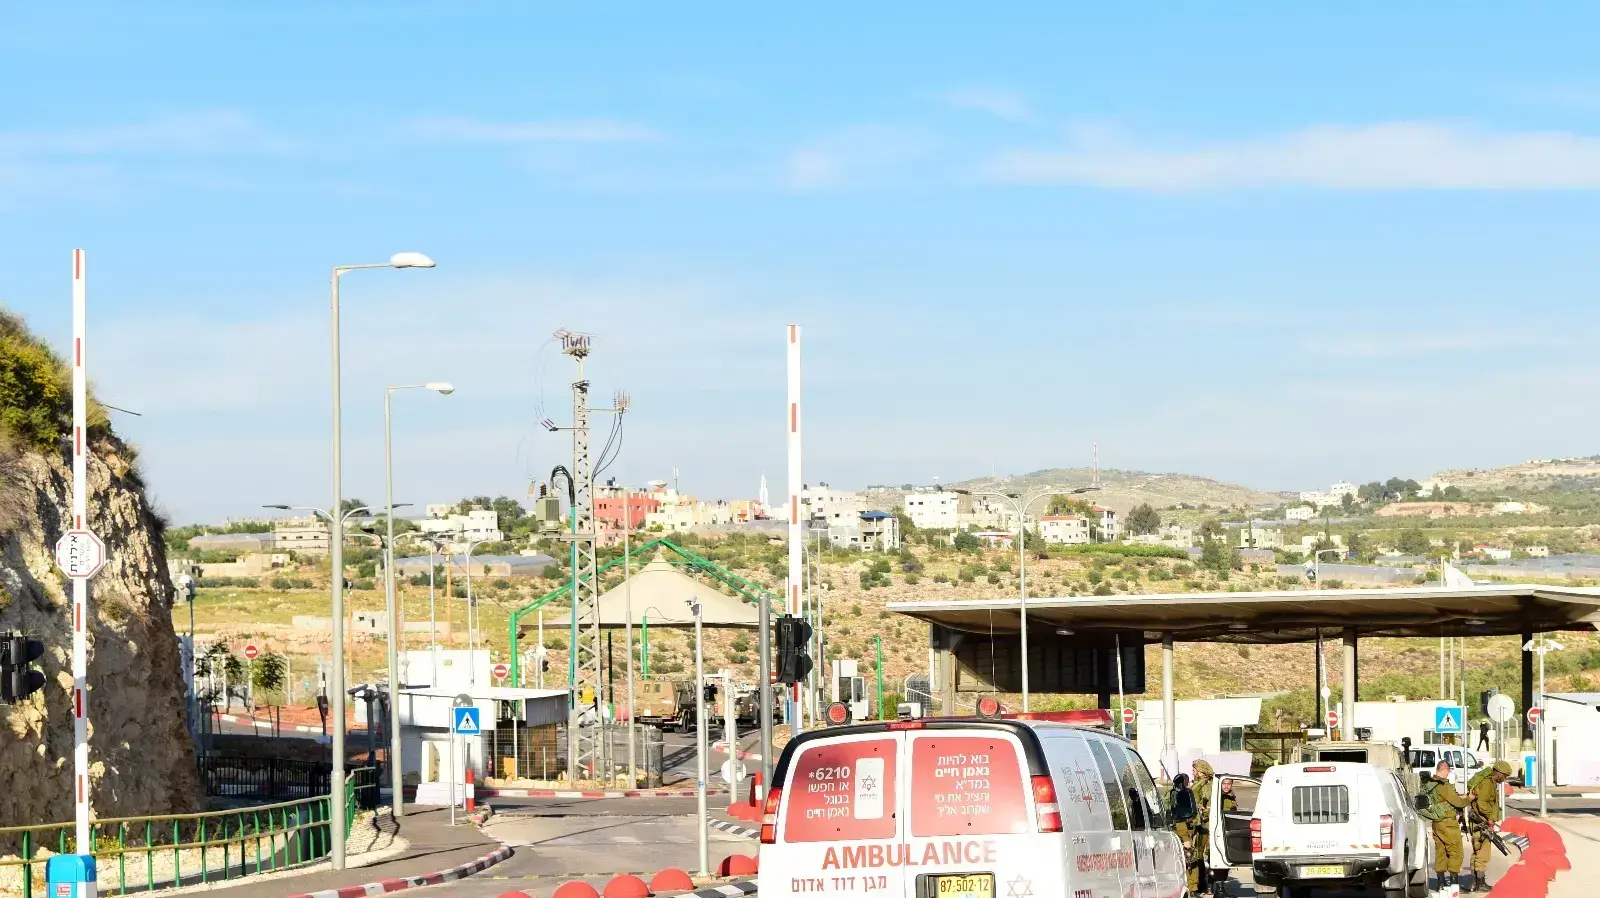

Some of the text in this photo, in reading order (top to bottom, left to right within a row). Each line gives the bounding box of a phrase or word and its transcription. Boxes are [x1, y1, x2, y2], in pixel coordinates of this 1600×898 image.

[937, 753, 990, 765] בוא להיות
[935, 768, 960, 777] חיים
[808, 781, 850, 793] או חפשו
[823, 794, 850, 804] בגוגל
[935, 791, 990, 802] ותציל את מי
[806, 807, 850, 819] נאמן חיים
[937, 804, 990, 818] שקרוב אליך
[821, 840, 997, 870] AMBULANCE
[791, 876, 887, 892] מגן דוד אדום
